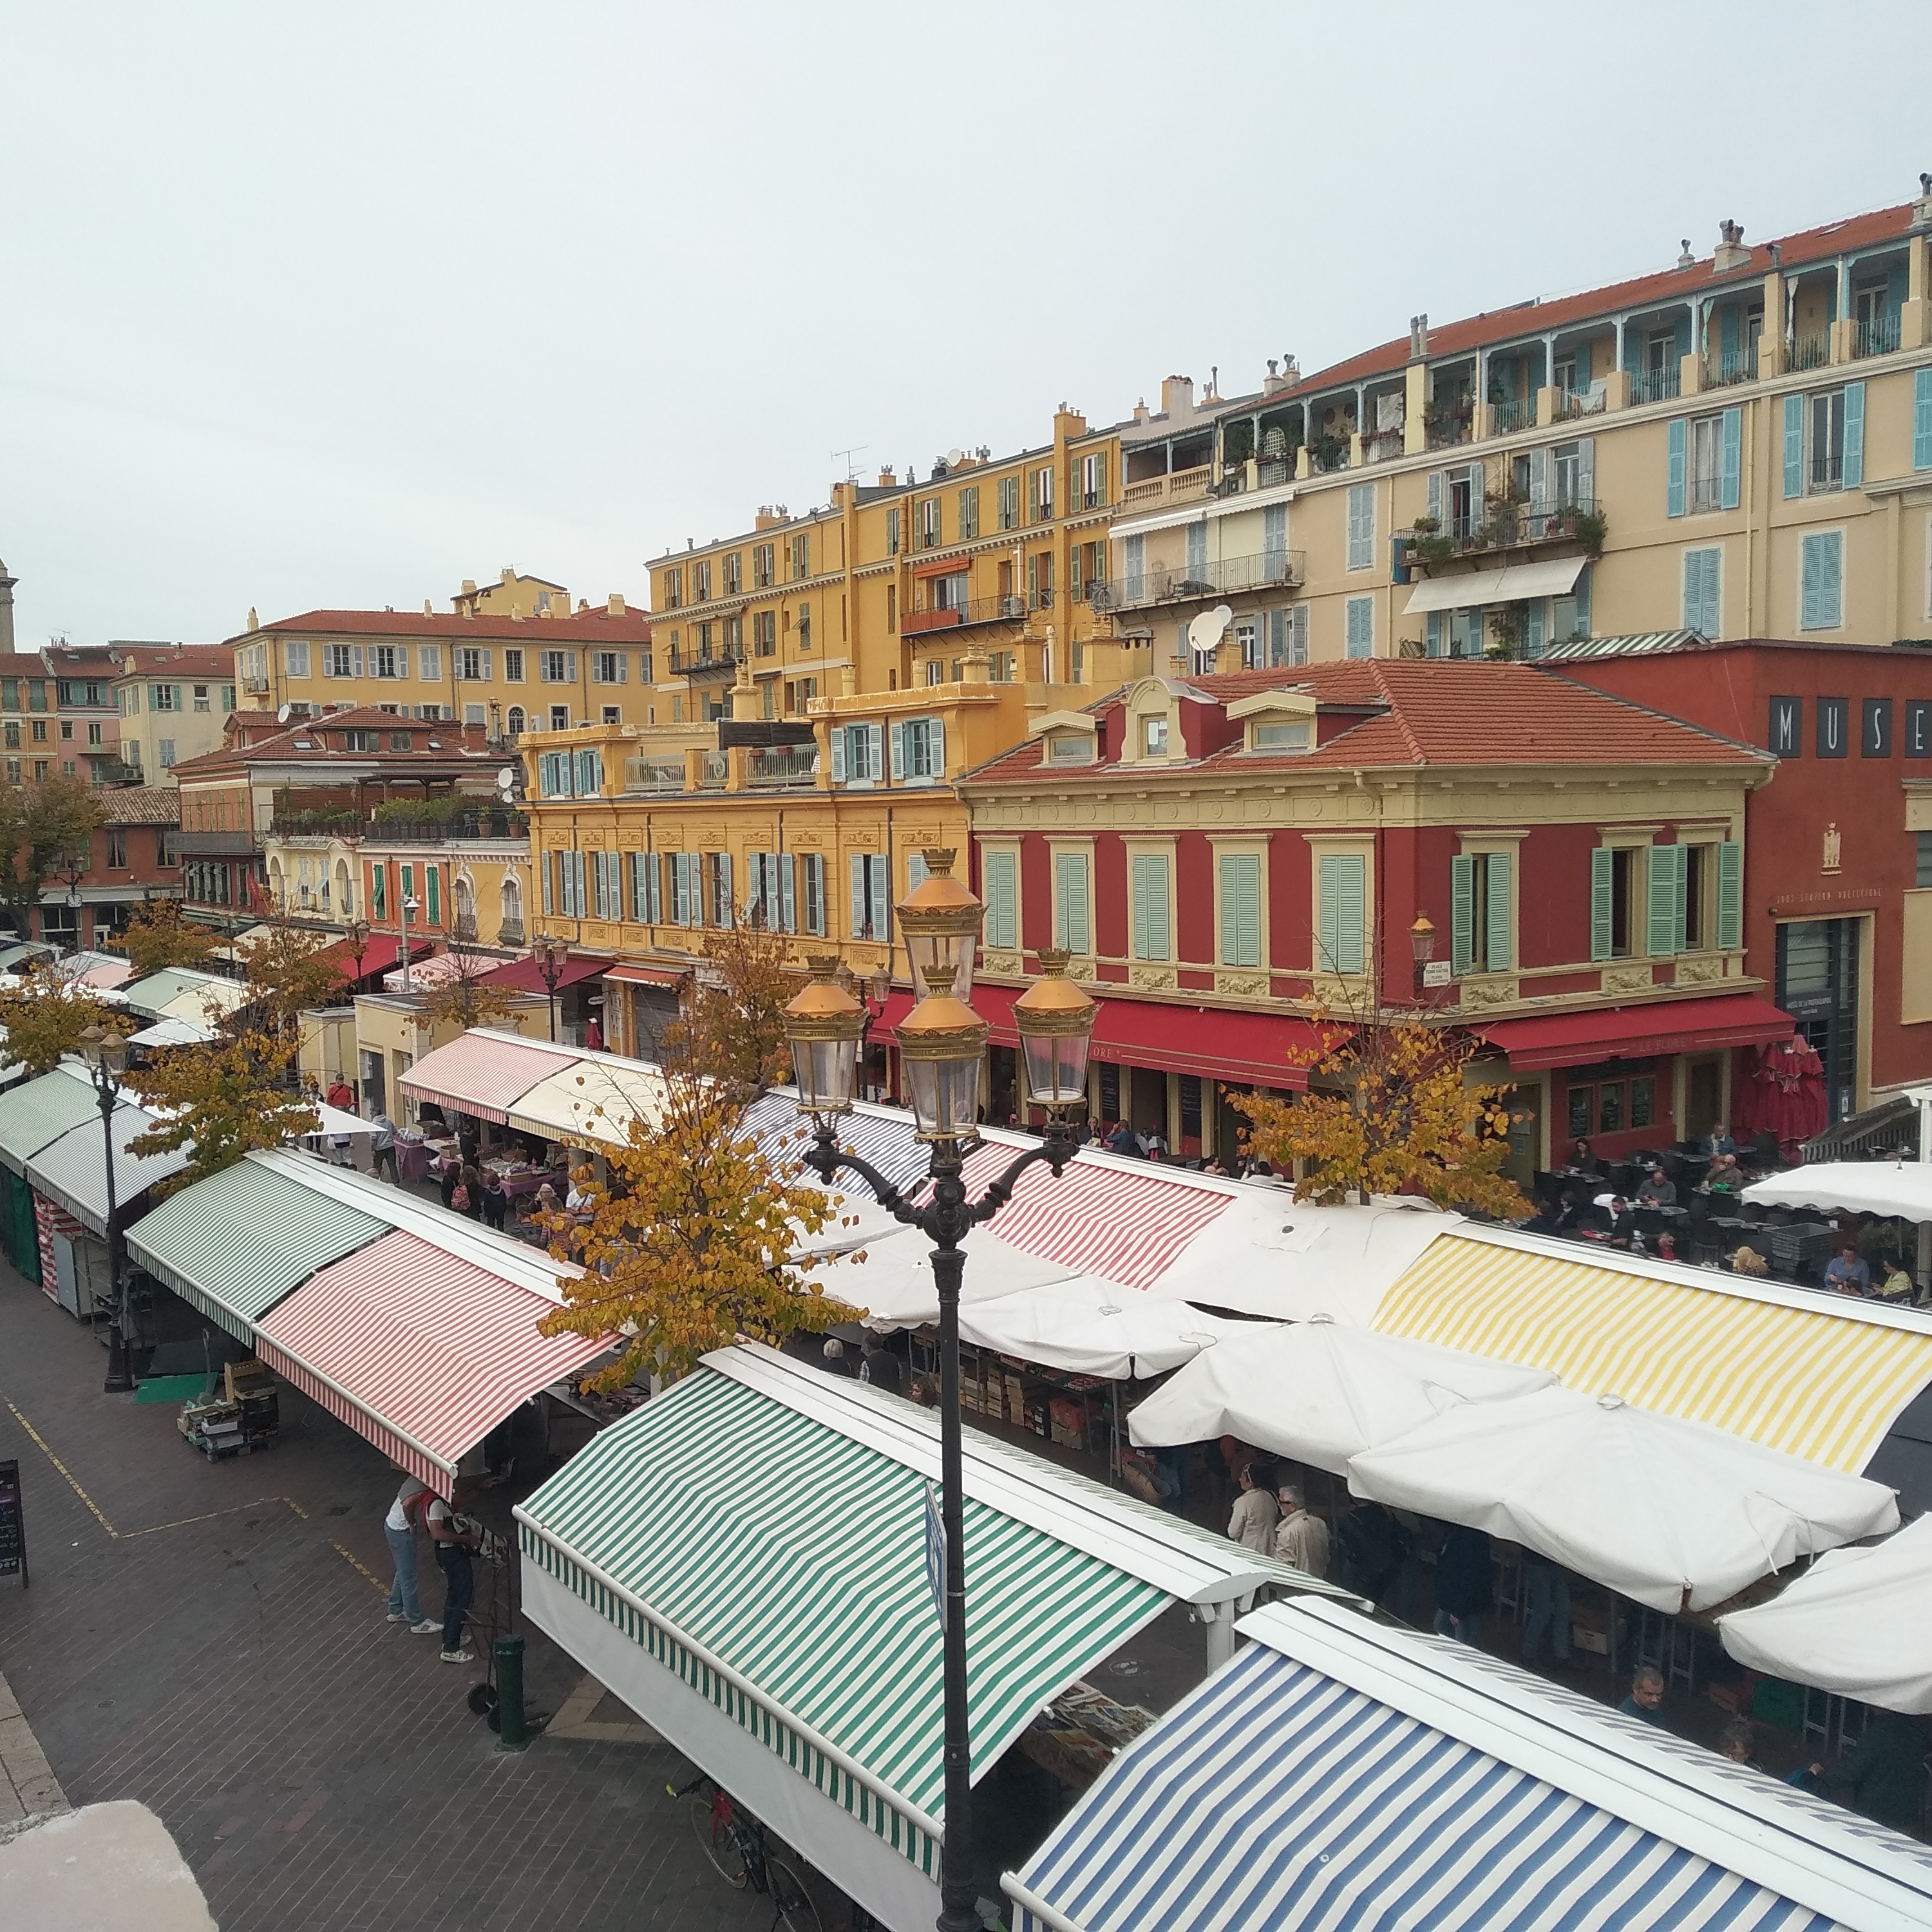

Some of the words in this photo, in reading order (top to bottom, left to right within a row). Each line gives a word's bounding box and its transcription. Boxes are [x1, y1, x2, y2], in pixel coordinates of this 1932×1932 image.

[1780, 705, 1924, 750] MUSE
[1776, 892, 1831, 904] SOUS-STATION
[1090, 1046, 1112, 1059] ORE
